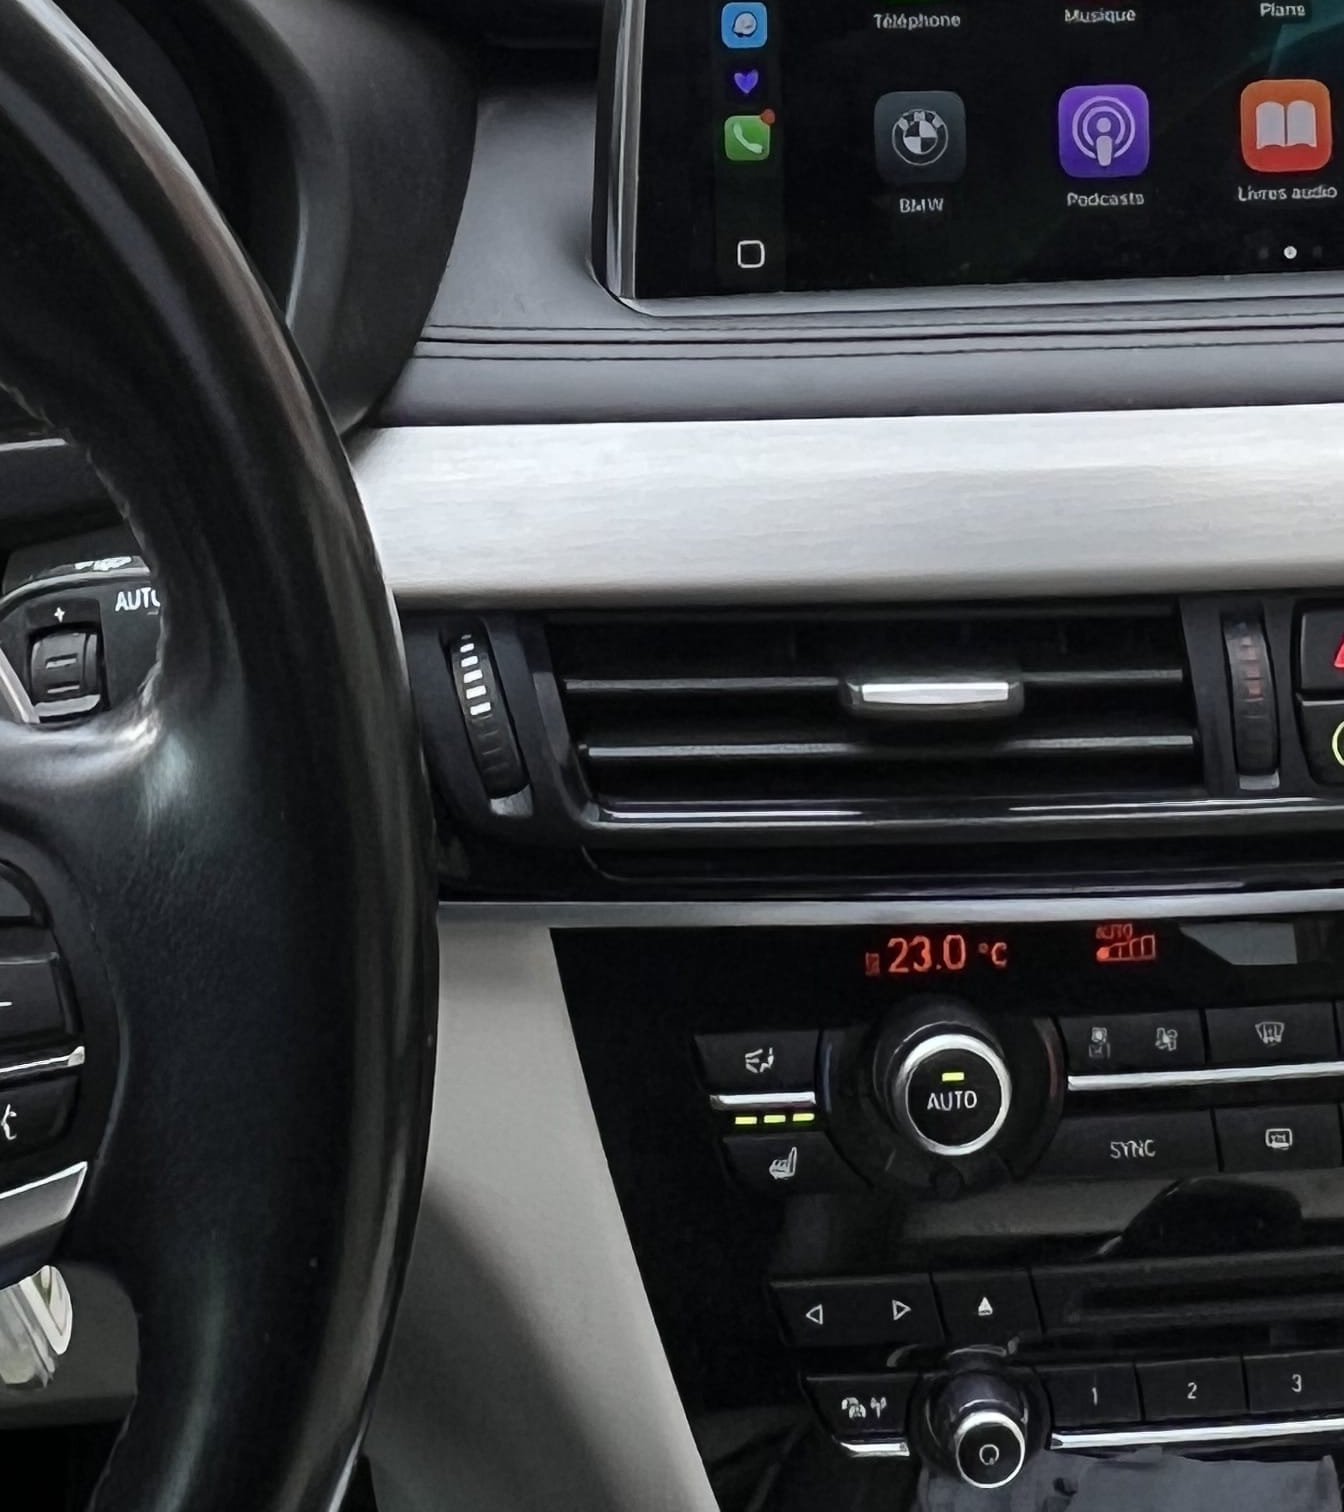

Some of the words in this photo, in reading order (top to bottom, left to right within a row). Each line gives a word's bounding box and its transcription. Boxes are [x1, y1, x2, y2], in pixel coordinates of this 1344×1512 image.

[1064, 7, 1137, 24] Musique
[1259, 2, 1306, 17] Plans
[873, 13, 961, 31] Téléphone
[1066, 192, 1145, 207] Podcasts
[1237, 185, 1285, 202] Livres
[1291, 184, 1338, 200] audio
[899, 197, 944, 213] BMW
[887, 934, 966, 973] 23.0
[927, 1090, 978, 1112] AUTO
[1110, 1139, 1156, 1159] SYNC
[1187, 1381, 1198, 1400] 2
[1291, 1374, 1302, 1393] 3
[1091, 1387, 1098, 1405] 1
